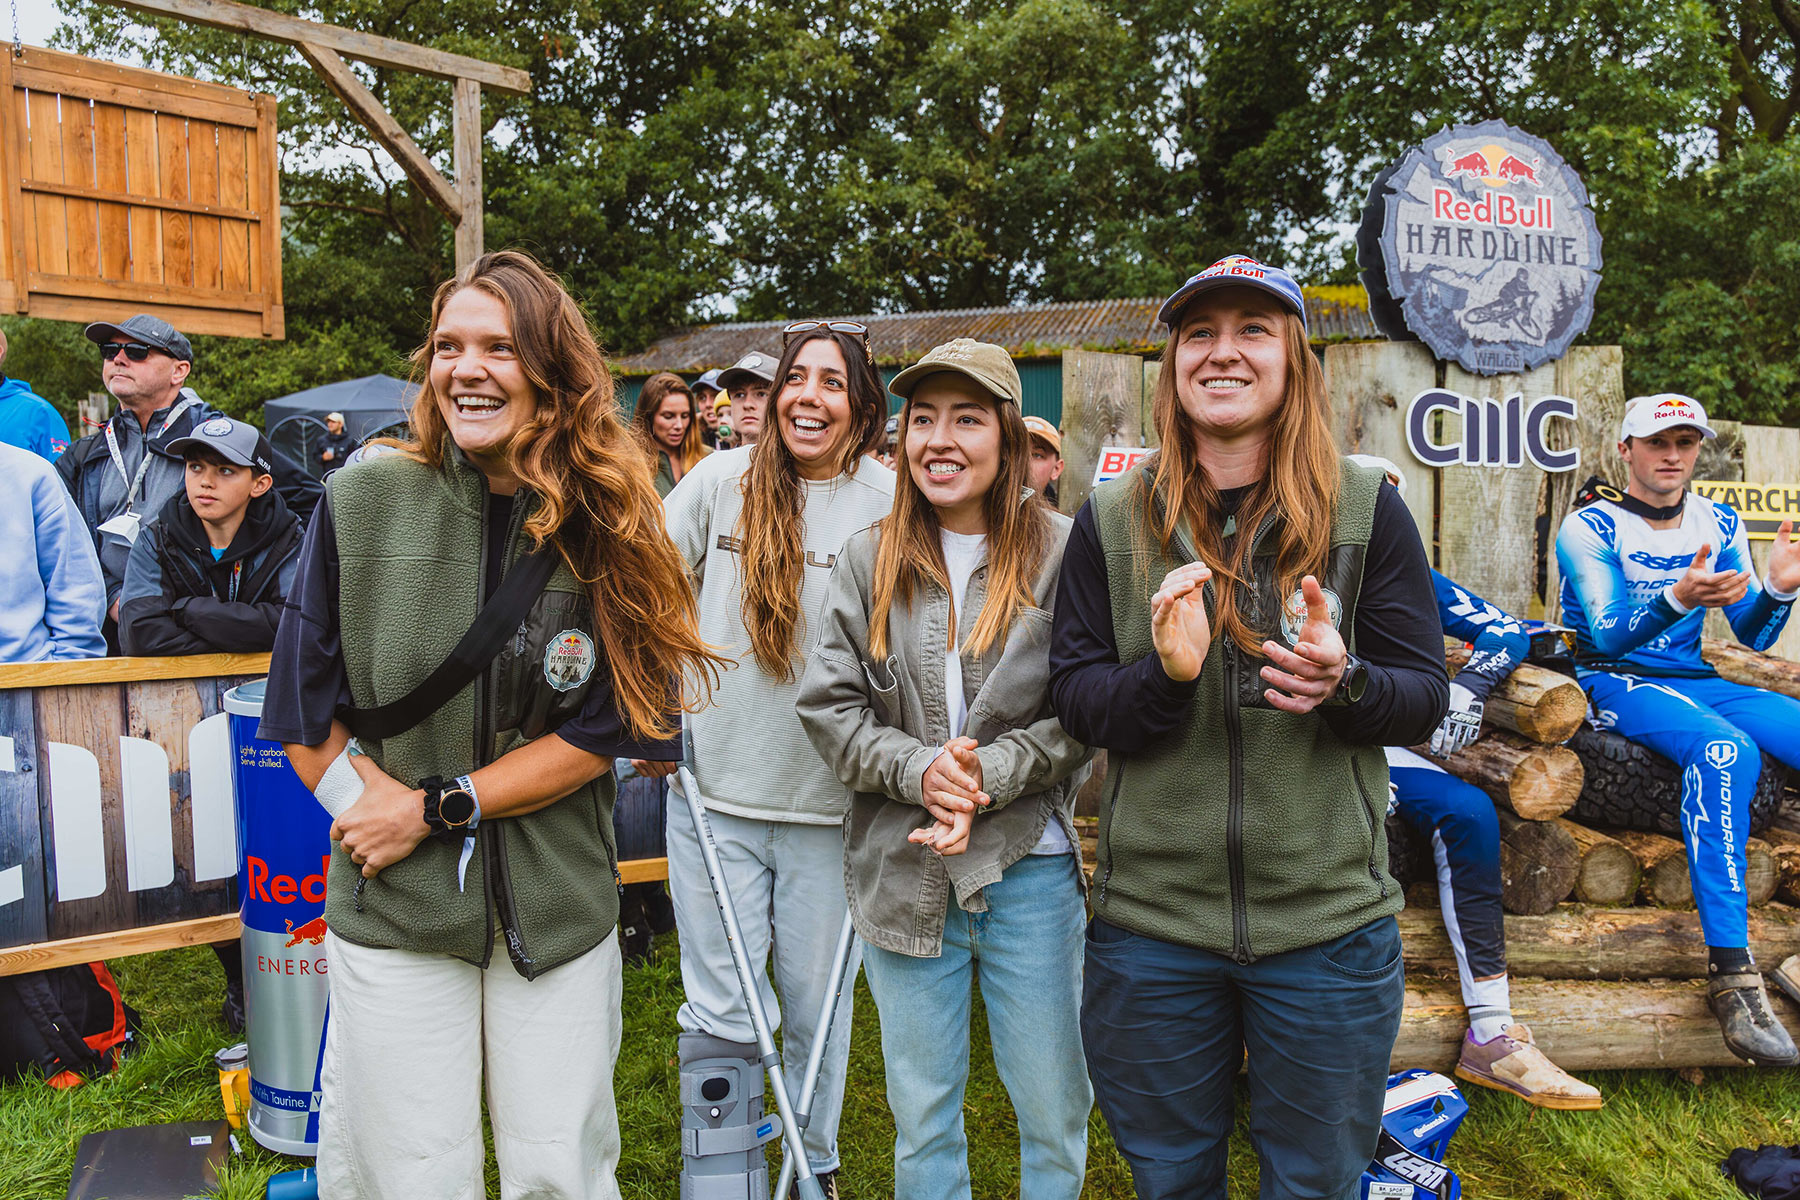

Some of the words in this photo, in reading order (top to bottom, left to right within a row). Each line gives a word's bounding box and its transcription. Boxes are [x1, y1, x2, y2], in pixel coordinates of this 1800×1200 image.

[1434, 189, 1491, 223] Red
[1497, 193, 1553, 229] Bull
[1406, 223, 1578, 266] HARDLINE
[1231, 267, 1264, 279] Bull
[1475, 352, 1521, 367] WALES
[1654, 409, 1675, 420] Red
[1678, 409, 1696, 420] Bull
[240, 756, 256, 767] Serve
[258, 758, 284, 768] chilled.
[247, 855, 331, 905] Red
[258, 955, 328, 976] ENERG
[270, 1090, 307, 1108] Taurine.
